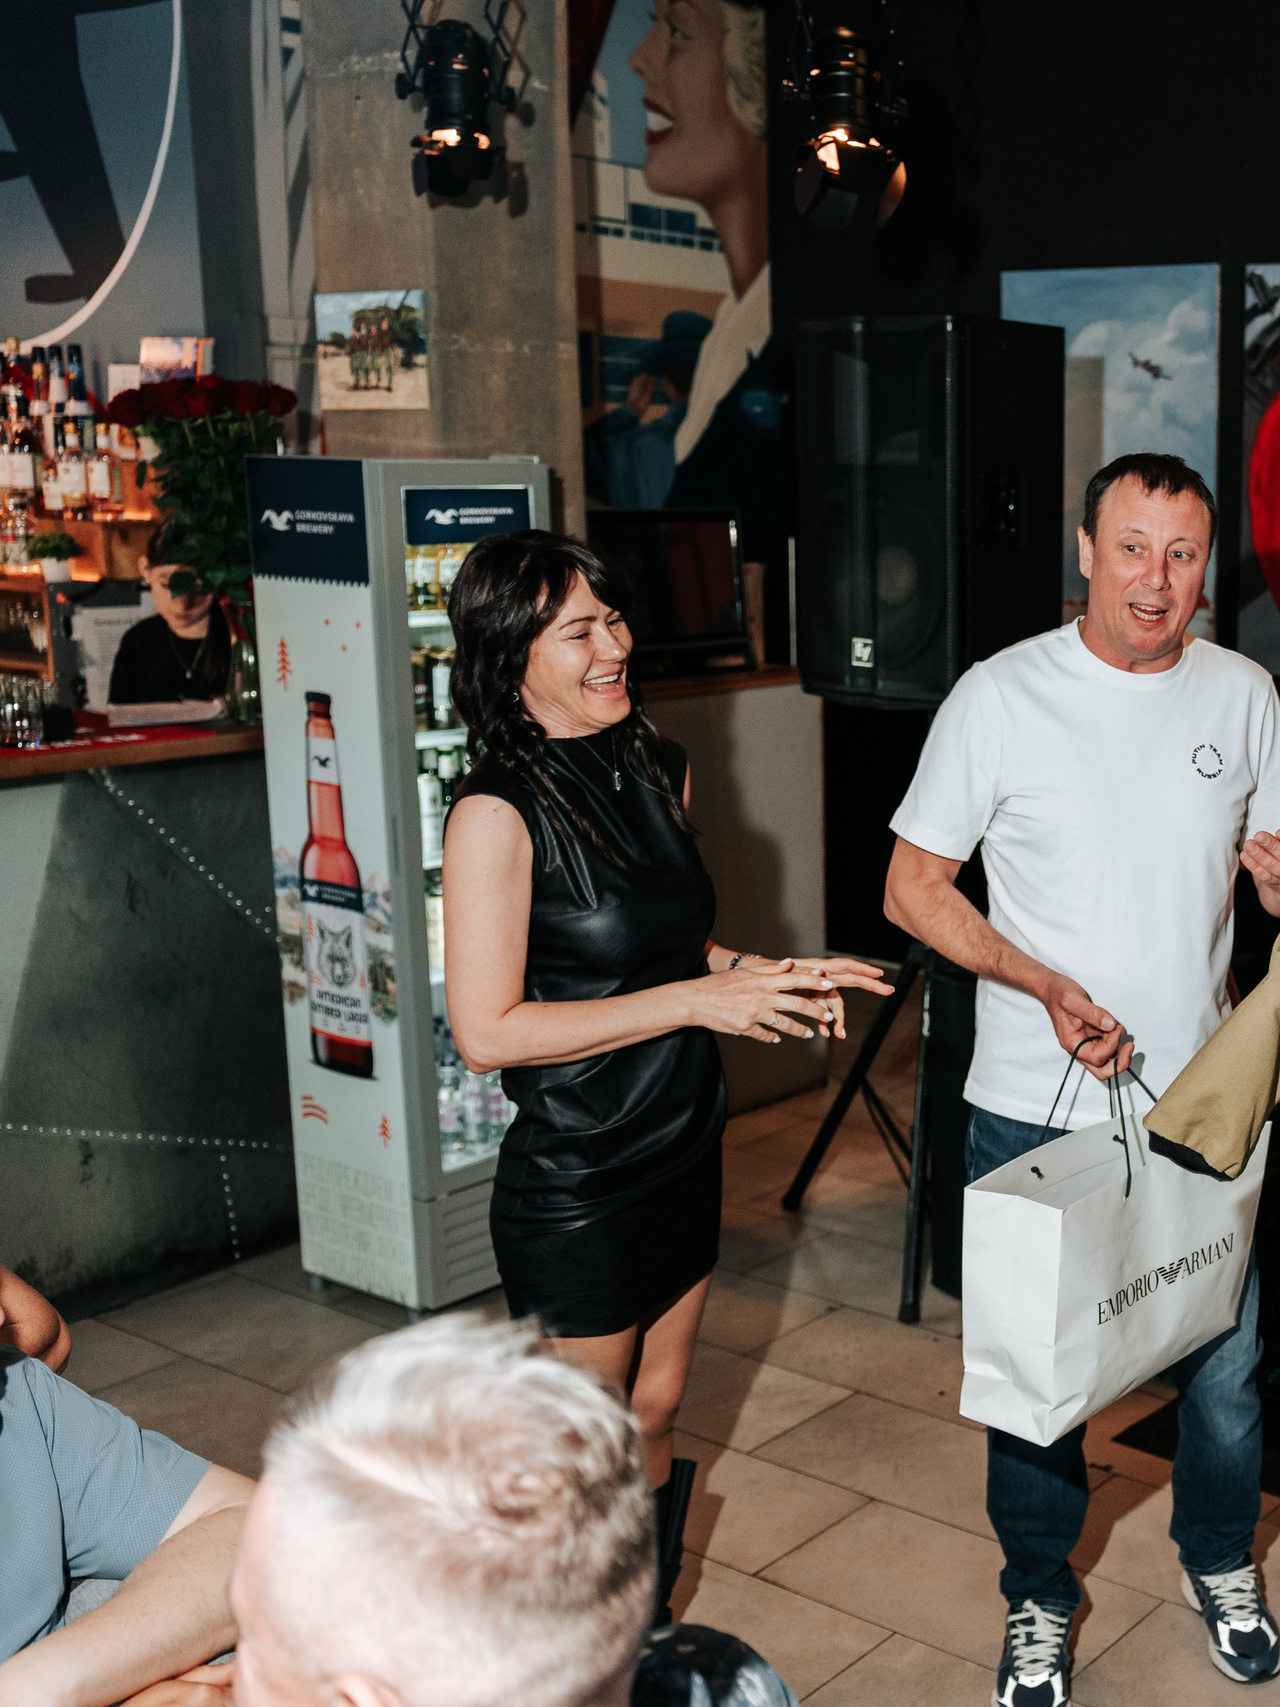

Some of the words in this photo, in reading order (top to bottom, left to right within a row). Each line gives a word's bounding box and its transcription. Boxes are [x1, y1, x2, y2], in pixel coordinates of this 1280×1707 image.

[294, 509, 355, 523] GORKOVSKAYA
[458, 507, 515, 516] GORKOVSKAYA
[459, 516, 496, 525] BREWERY
[296, 523, 335, 535] BREWERY
[1191, 744, 1205, 765] PUTIN
[1209, 743, 1223, 766] TEAM
[1196, 767, 1223, 779] RUSSIA
[316, 989, 361, 1008] AMERICAN
[310, 1000, 341, 1019] AMBER
[1097, 1269, 1159, 1325] EMPORIO
[1181, 1232, 1234, 1279] ARMANI
